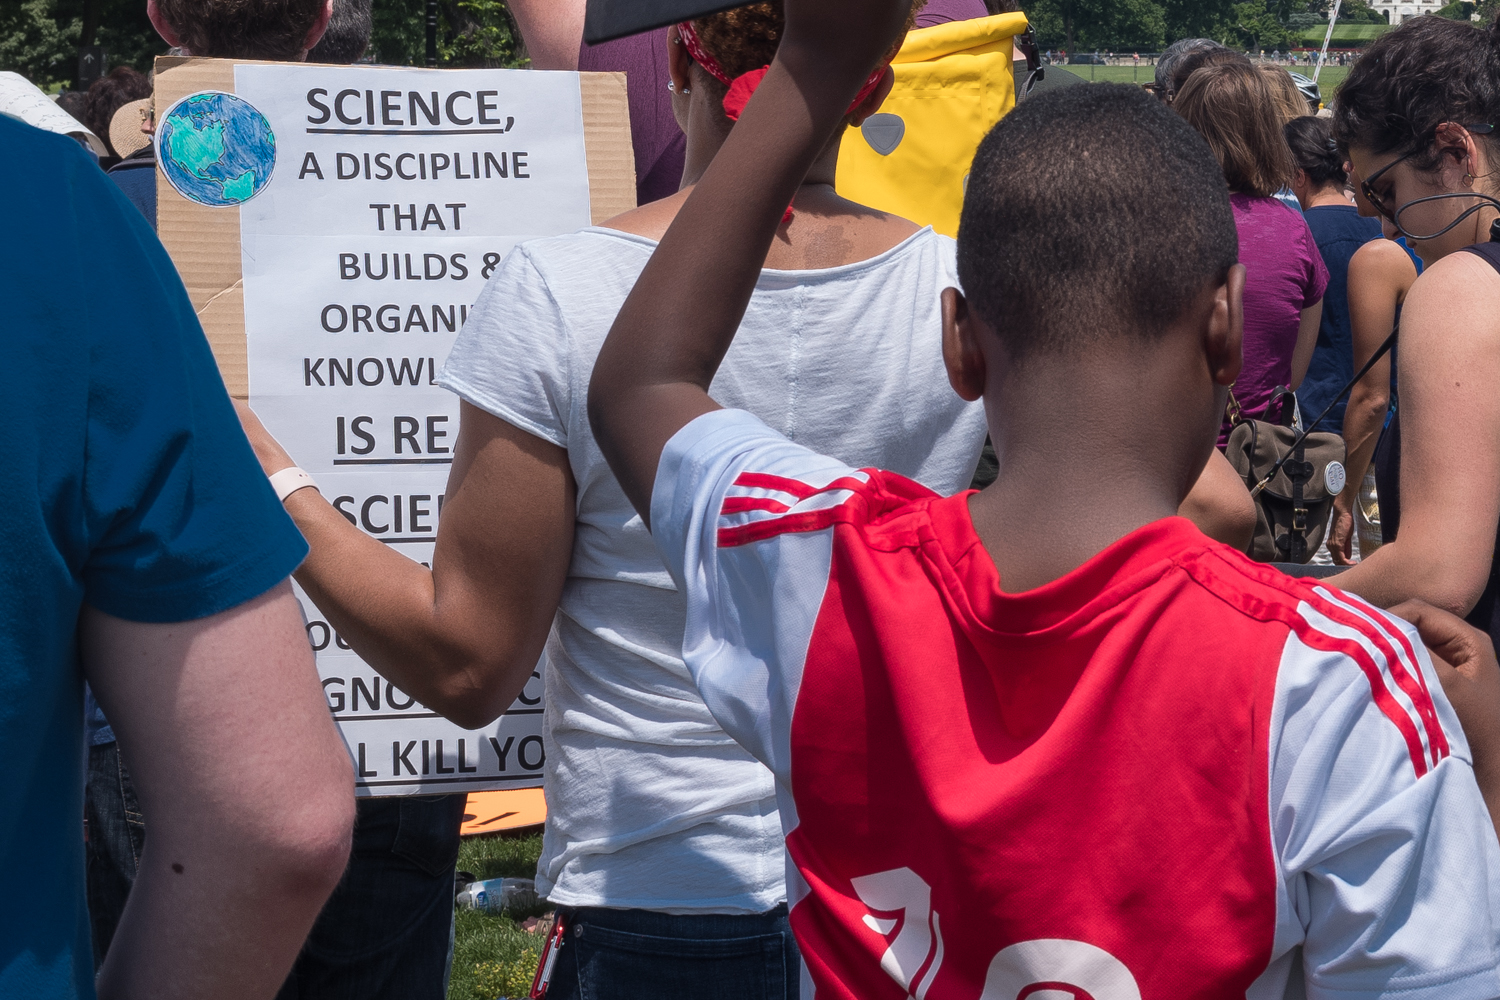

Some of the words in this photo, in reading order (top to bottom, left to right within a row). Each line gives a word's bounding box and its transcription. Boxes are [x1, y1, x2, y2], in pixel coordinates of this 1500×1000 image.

[307, 88, 515, 132] SCIENCE,
[298, 153, 324, 180] A
[336, 151, 531, 180] DISCIPLINE
[370, 203, 467, 231] THAT
[339, 252, 469, 281] BUILDS
[481, 252, 501, 280] &
[321, 304, 475, 333] ORGANI
[304, 357, 440, 386] KNOWL
[336, 416, 376, 454] IS
[393, 415, 458, 454] RE
[393, 739, 477, 776] KILL
